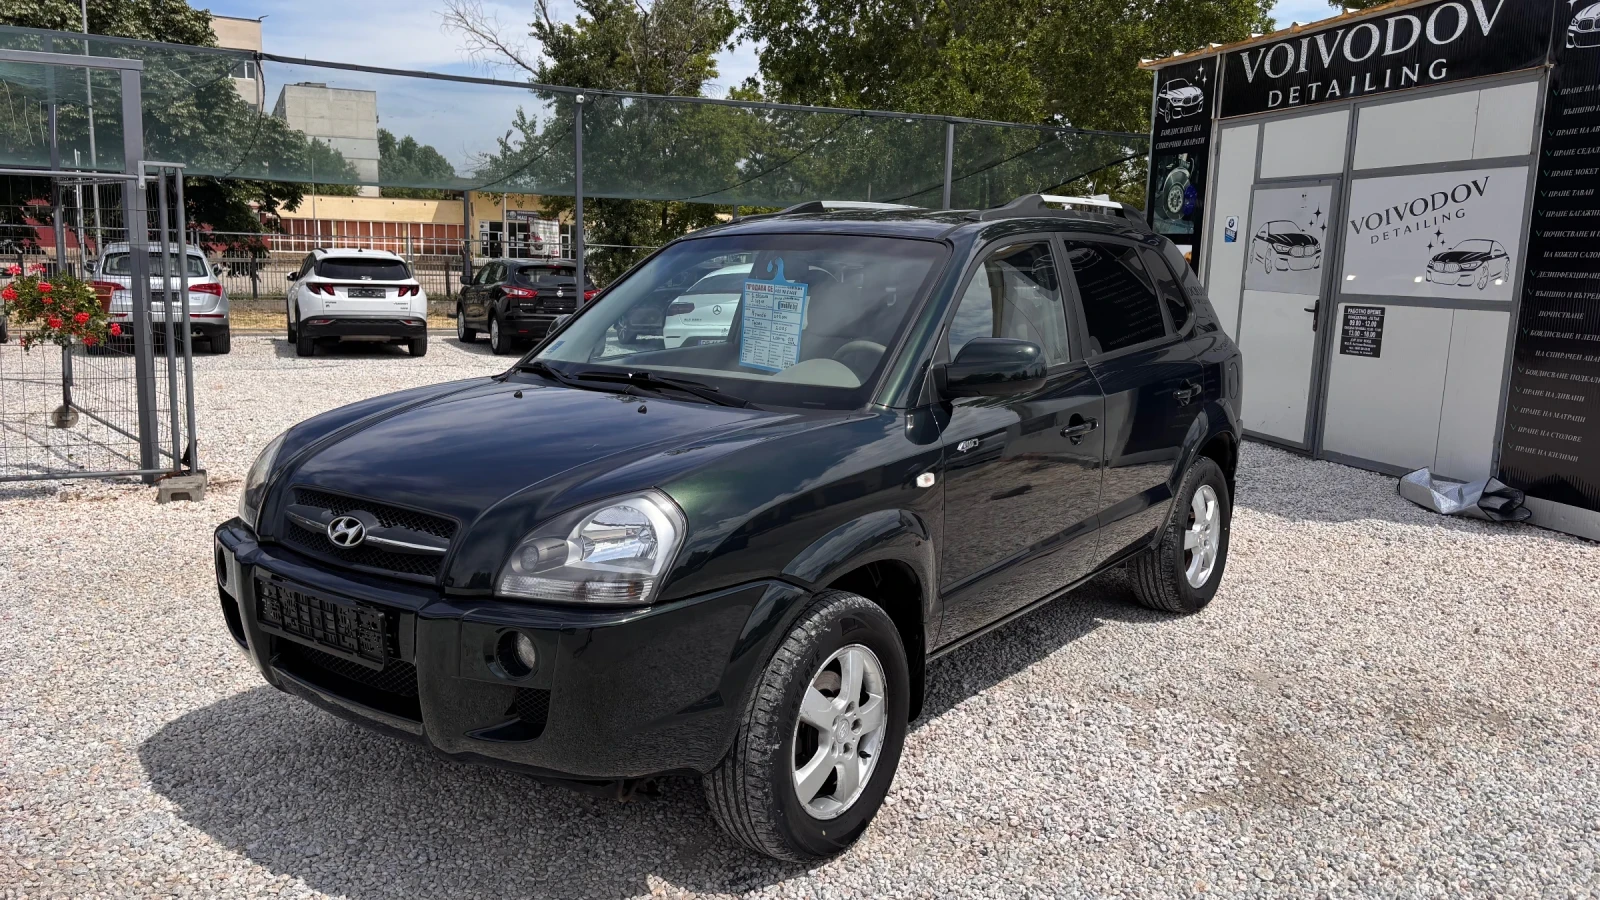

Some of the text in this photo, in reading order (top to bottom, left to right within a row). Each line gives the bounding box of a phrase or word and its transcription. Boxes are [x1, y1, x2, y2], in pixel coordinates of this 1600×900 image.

[1240, 0, 1502, 83] VOIVODOV
[1268, 58, 1447, 107] DETAILING
[1560, 86, 1584, 95] ПРАНЕ
[1585, 84, 1594, 92] НА
[1556, 128, 1578, 136] ПРАНЕ
[1580, 126, 1589, 134] НА
[1554, 148, 1576, 156] ПРАНЕ
[1551, 168, 1599, 177] ПРАНЕ МОКЕТ
[1350, 176, 1490, 234] VOIVODOV
[1370, 208, 1465, 244] DETAILING
[1539, 310, 1585, 319] ПОЧИСТВАНЕ
[1530, 329, 1574, 339] БОЯДИСВАНЕ
[1546, 351, 1583, 360] СПИРАЧЕН
[1525, 368, 1569, 379] БОЯДИСВАНЕ
[1522, 388, 1585, 402] ПРАНЕ НА ДИВАНИ
[1520, 407, 1542, 416] ПРАНЕ
[1553, 412, 1586, 423] МАТРАЦИ
[1518, 426, 1540, 435] ПРАНЕ
[1550, 432, 1582, 442] СТОЛОВЕ
[1515, 445, 1579, 462] ПРАНЕ НА КИЛИМИ
